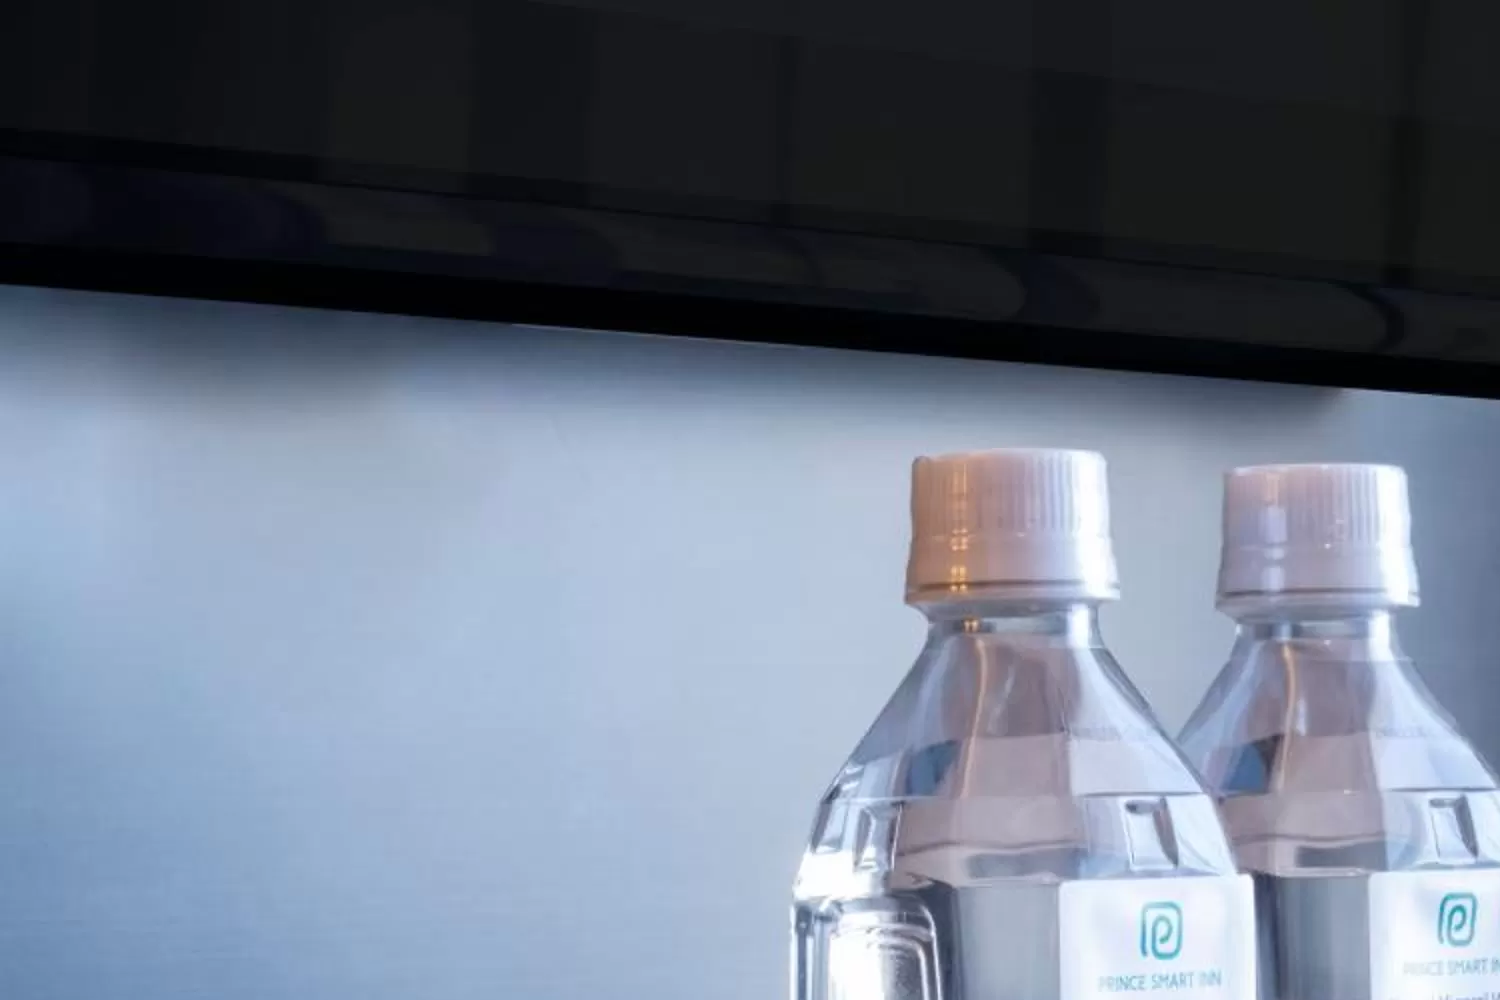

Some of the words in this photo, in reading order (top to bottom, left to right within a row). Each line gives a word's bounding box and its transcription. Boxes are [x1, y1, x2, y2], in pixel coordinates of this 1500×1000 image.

[1448, 958, 1488, 974] SMART
[1098, 975, 1145, 992] PRINCE
[1151, 972, 1194, 990] SMART
[1199, 969, 1222, 987] INN
